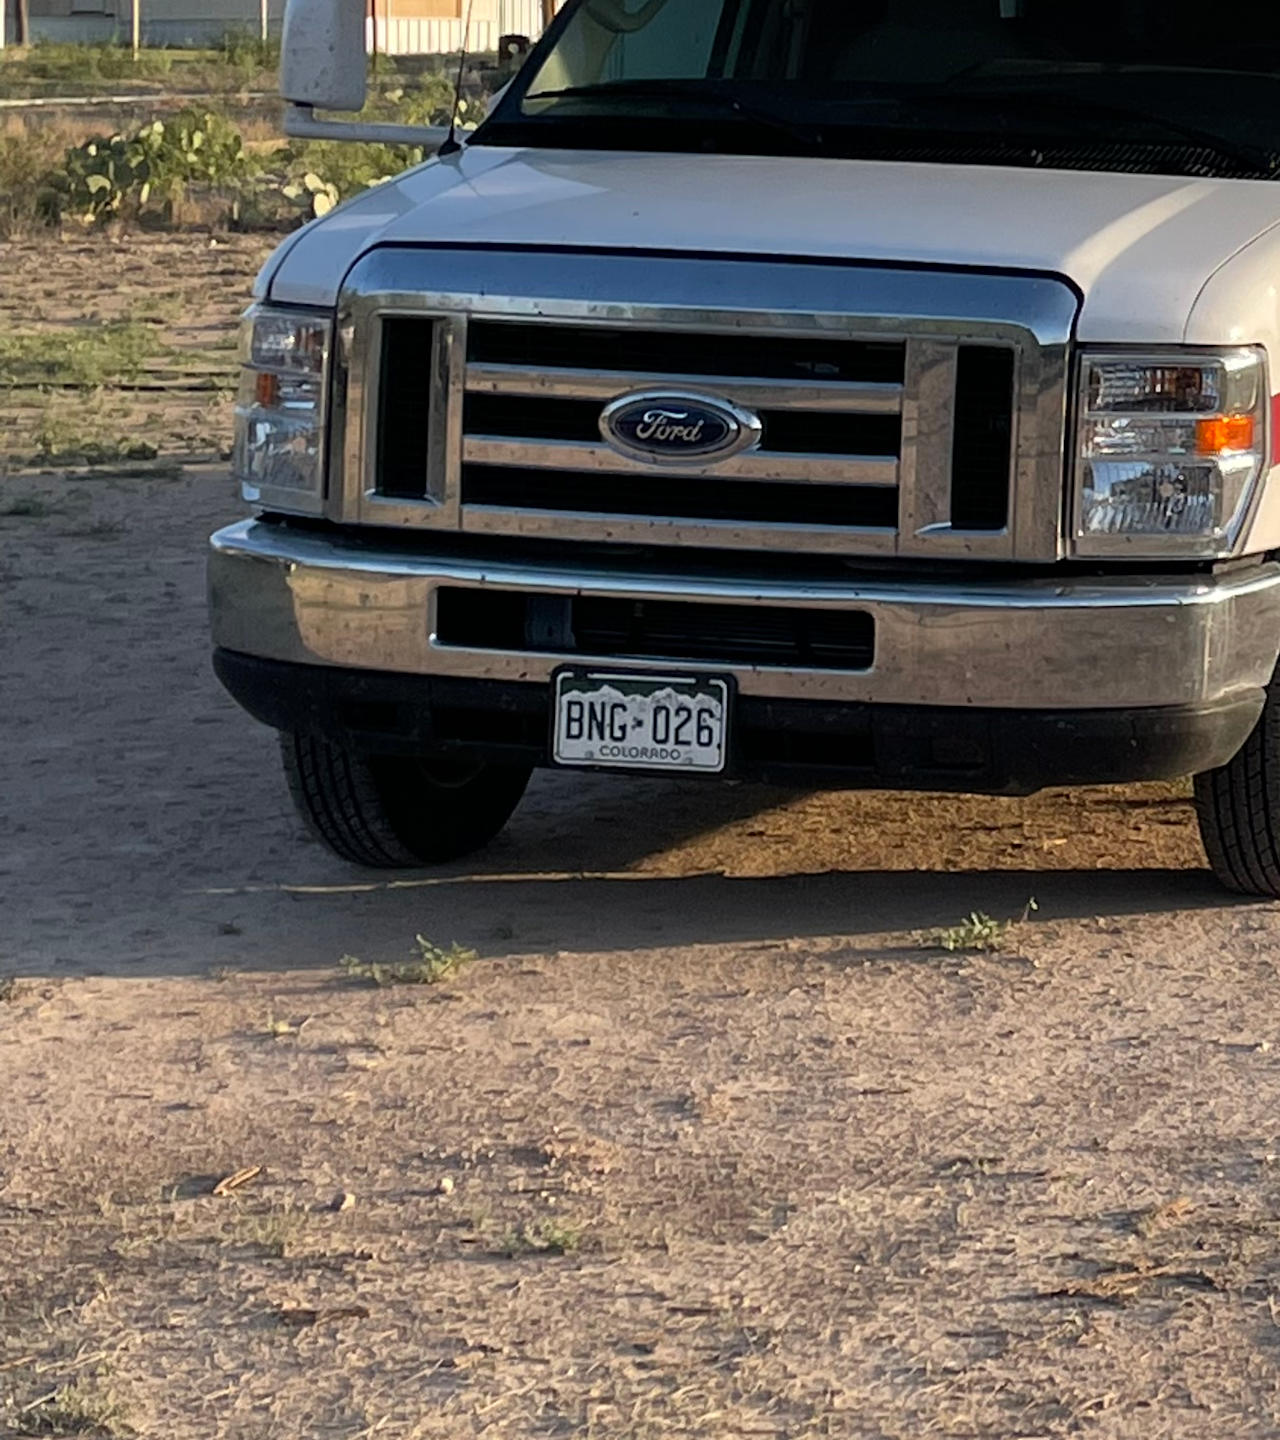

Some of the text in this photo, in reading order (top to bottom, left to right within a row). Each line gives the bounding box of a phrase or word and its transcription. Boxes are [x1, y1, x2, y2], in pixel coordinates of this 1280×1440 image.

[635, 409, 704, 442] Ford
[565, 700, 717, 748] BNG 026
[599, 744, 682, 761] COLORADO
